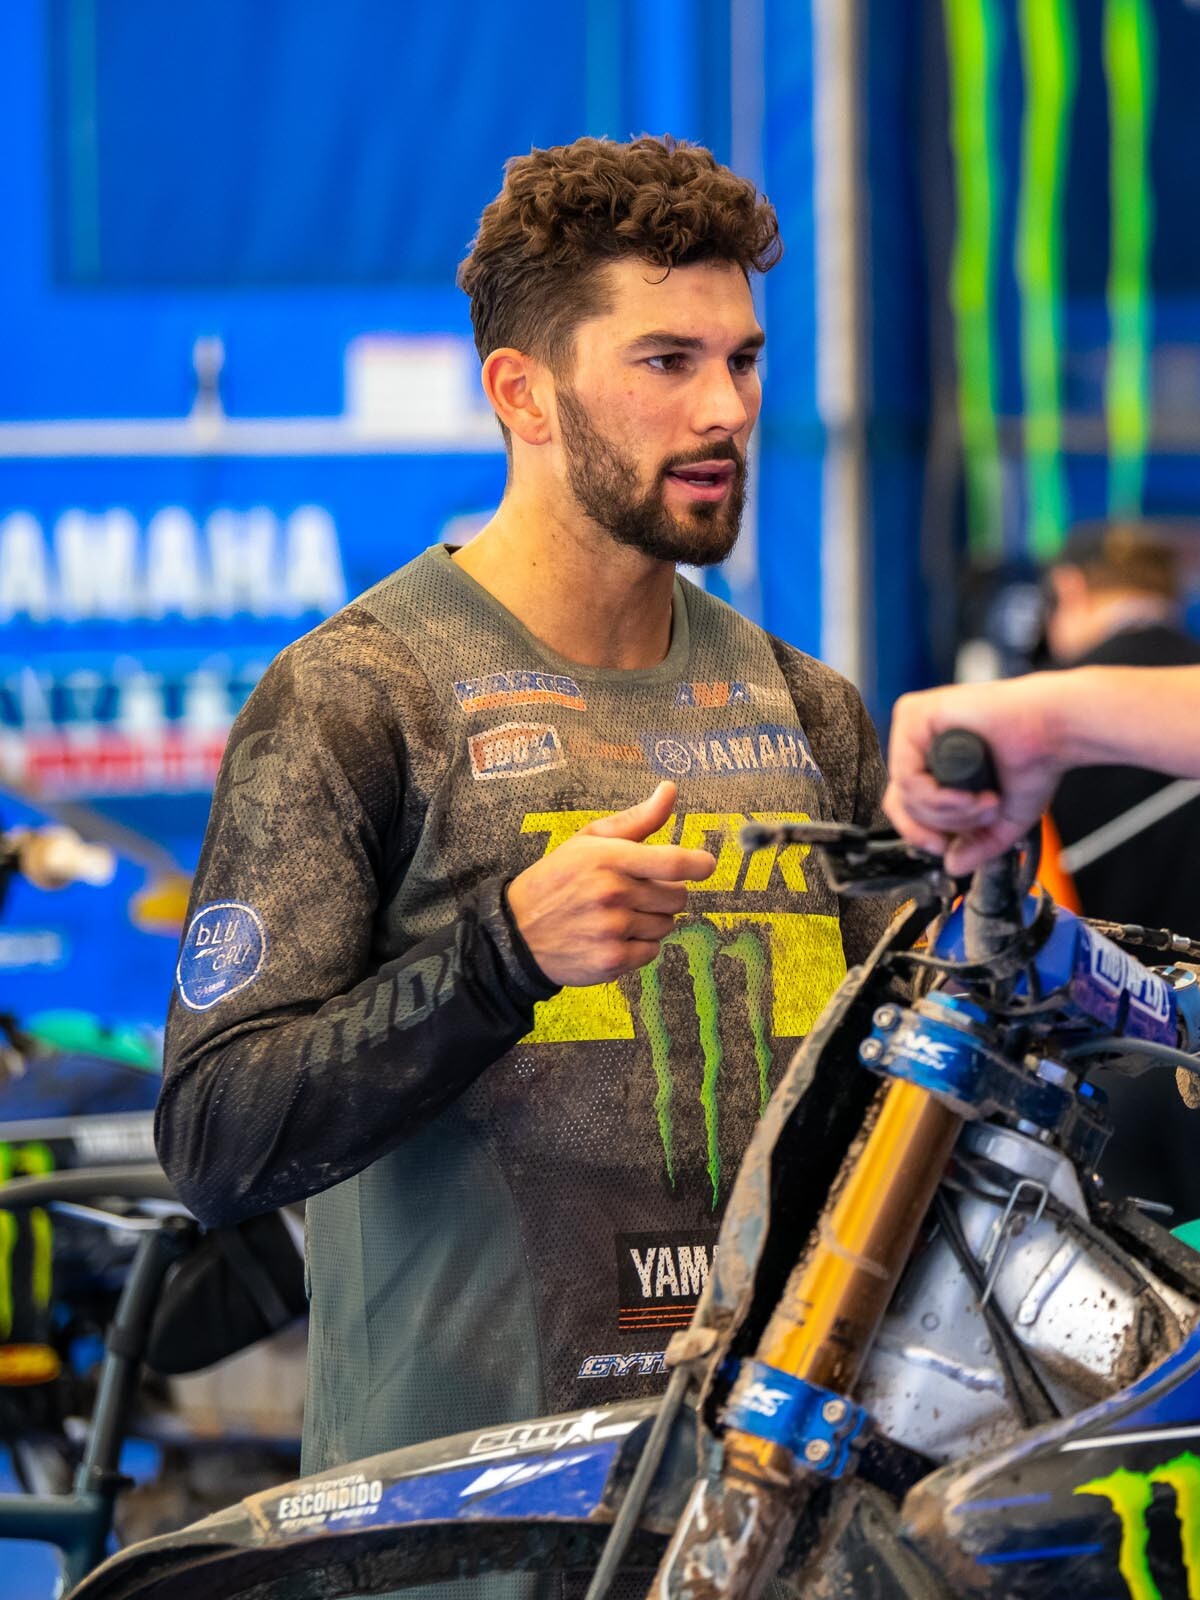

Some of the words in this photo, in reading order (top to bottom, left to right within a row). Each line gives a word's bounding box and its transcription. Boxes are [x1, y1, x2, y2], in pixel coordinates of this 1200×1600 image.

[0, 506, 347, 622] AMAHA
[672, 682, 750, 709] AMA
[687, 734, 818, 771] YAMAHA
[629, 1244, 720, 1298] YAM
[577, 1351, 672, 1379] GYT
[278, 1480, 383, 1519] ESCONDIDO
